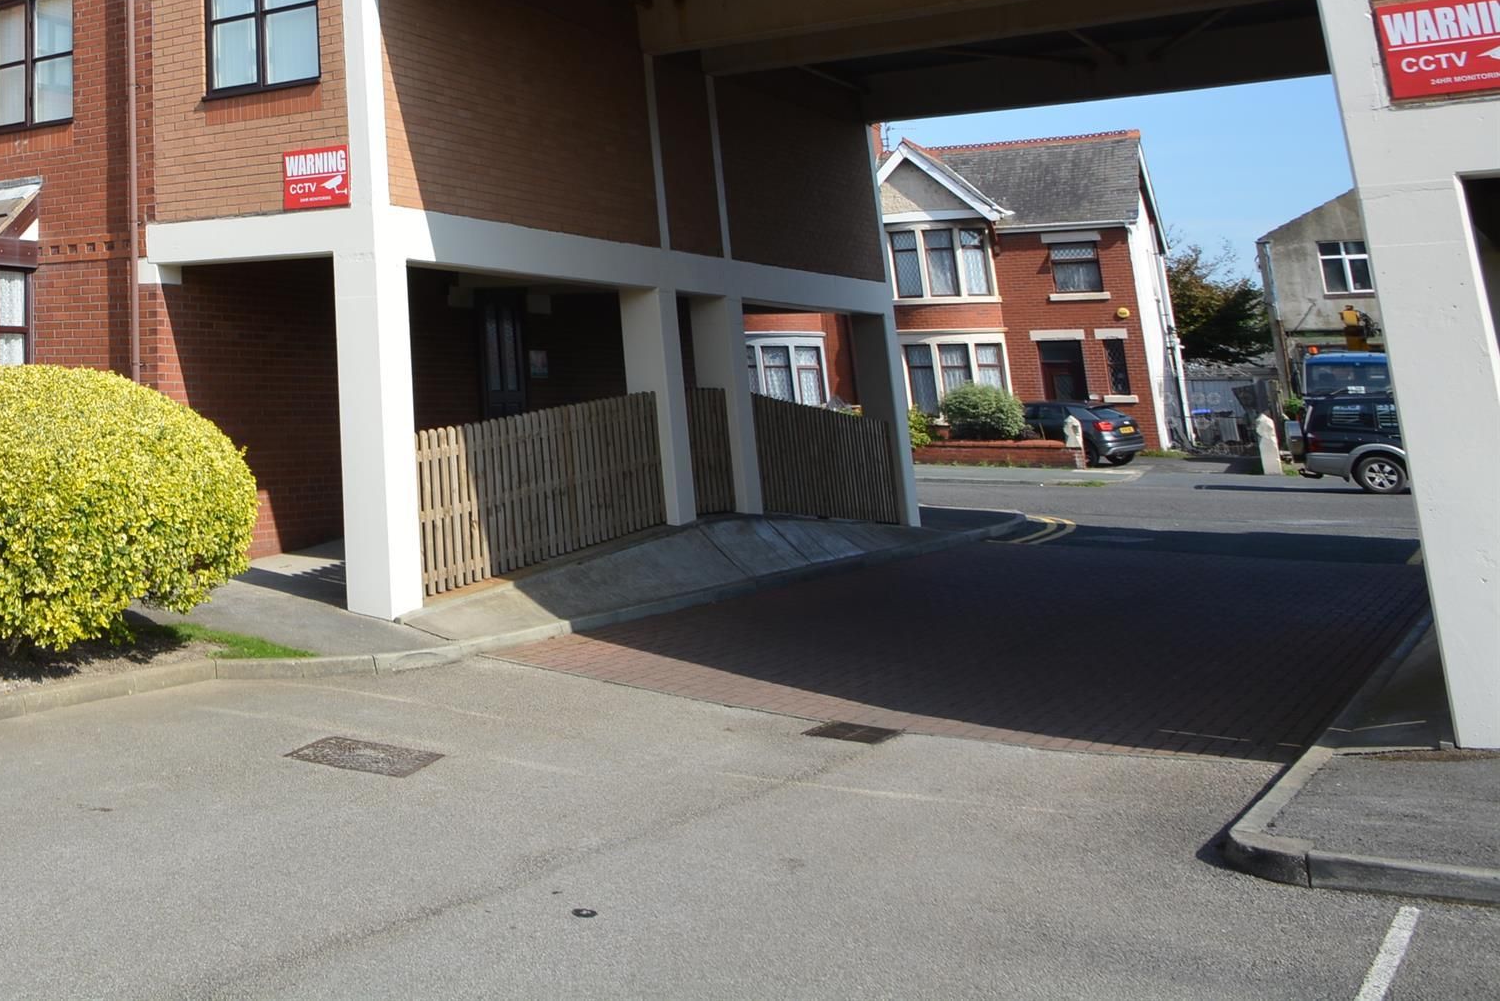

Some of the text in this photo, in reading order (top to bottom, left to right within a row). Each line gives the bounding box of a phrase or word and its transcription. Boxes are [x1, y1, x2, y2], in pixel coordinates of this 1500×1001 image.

[1401, 51, 1467, 73] CCTV
[285, 150, 346, 176] WARNING
[289, 183, 317, 194] CCTV
